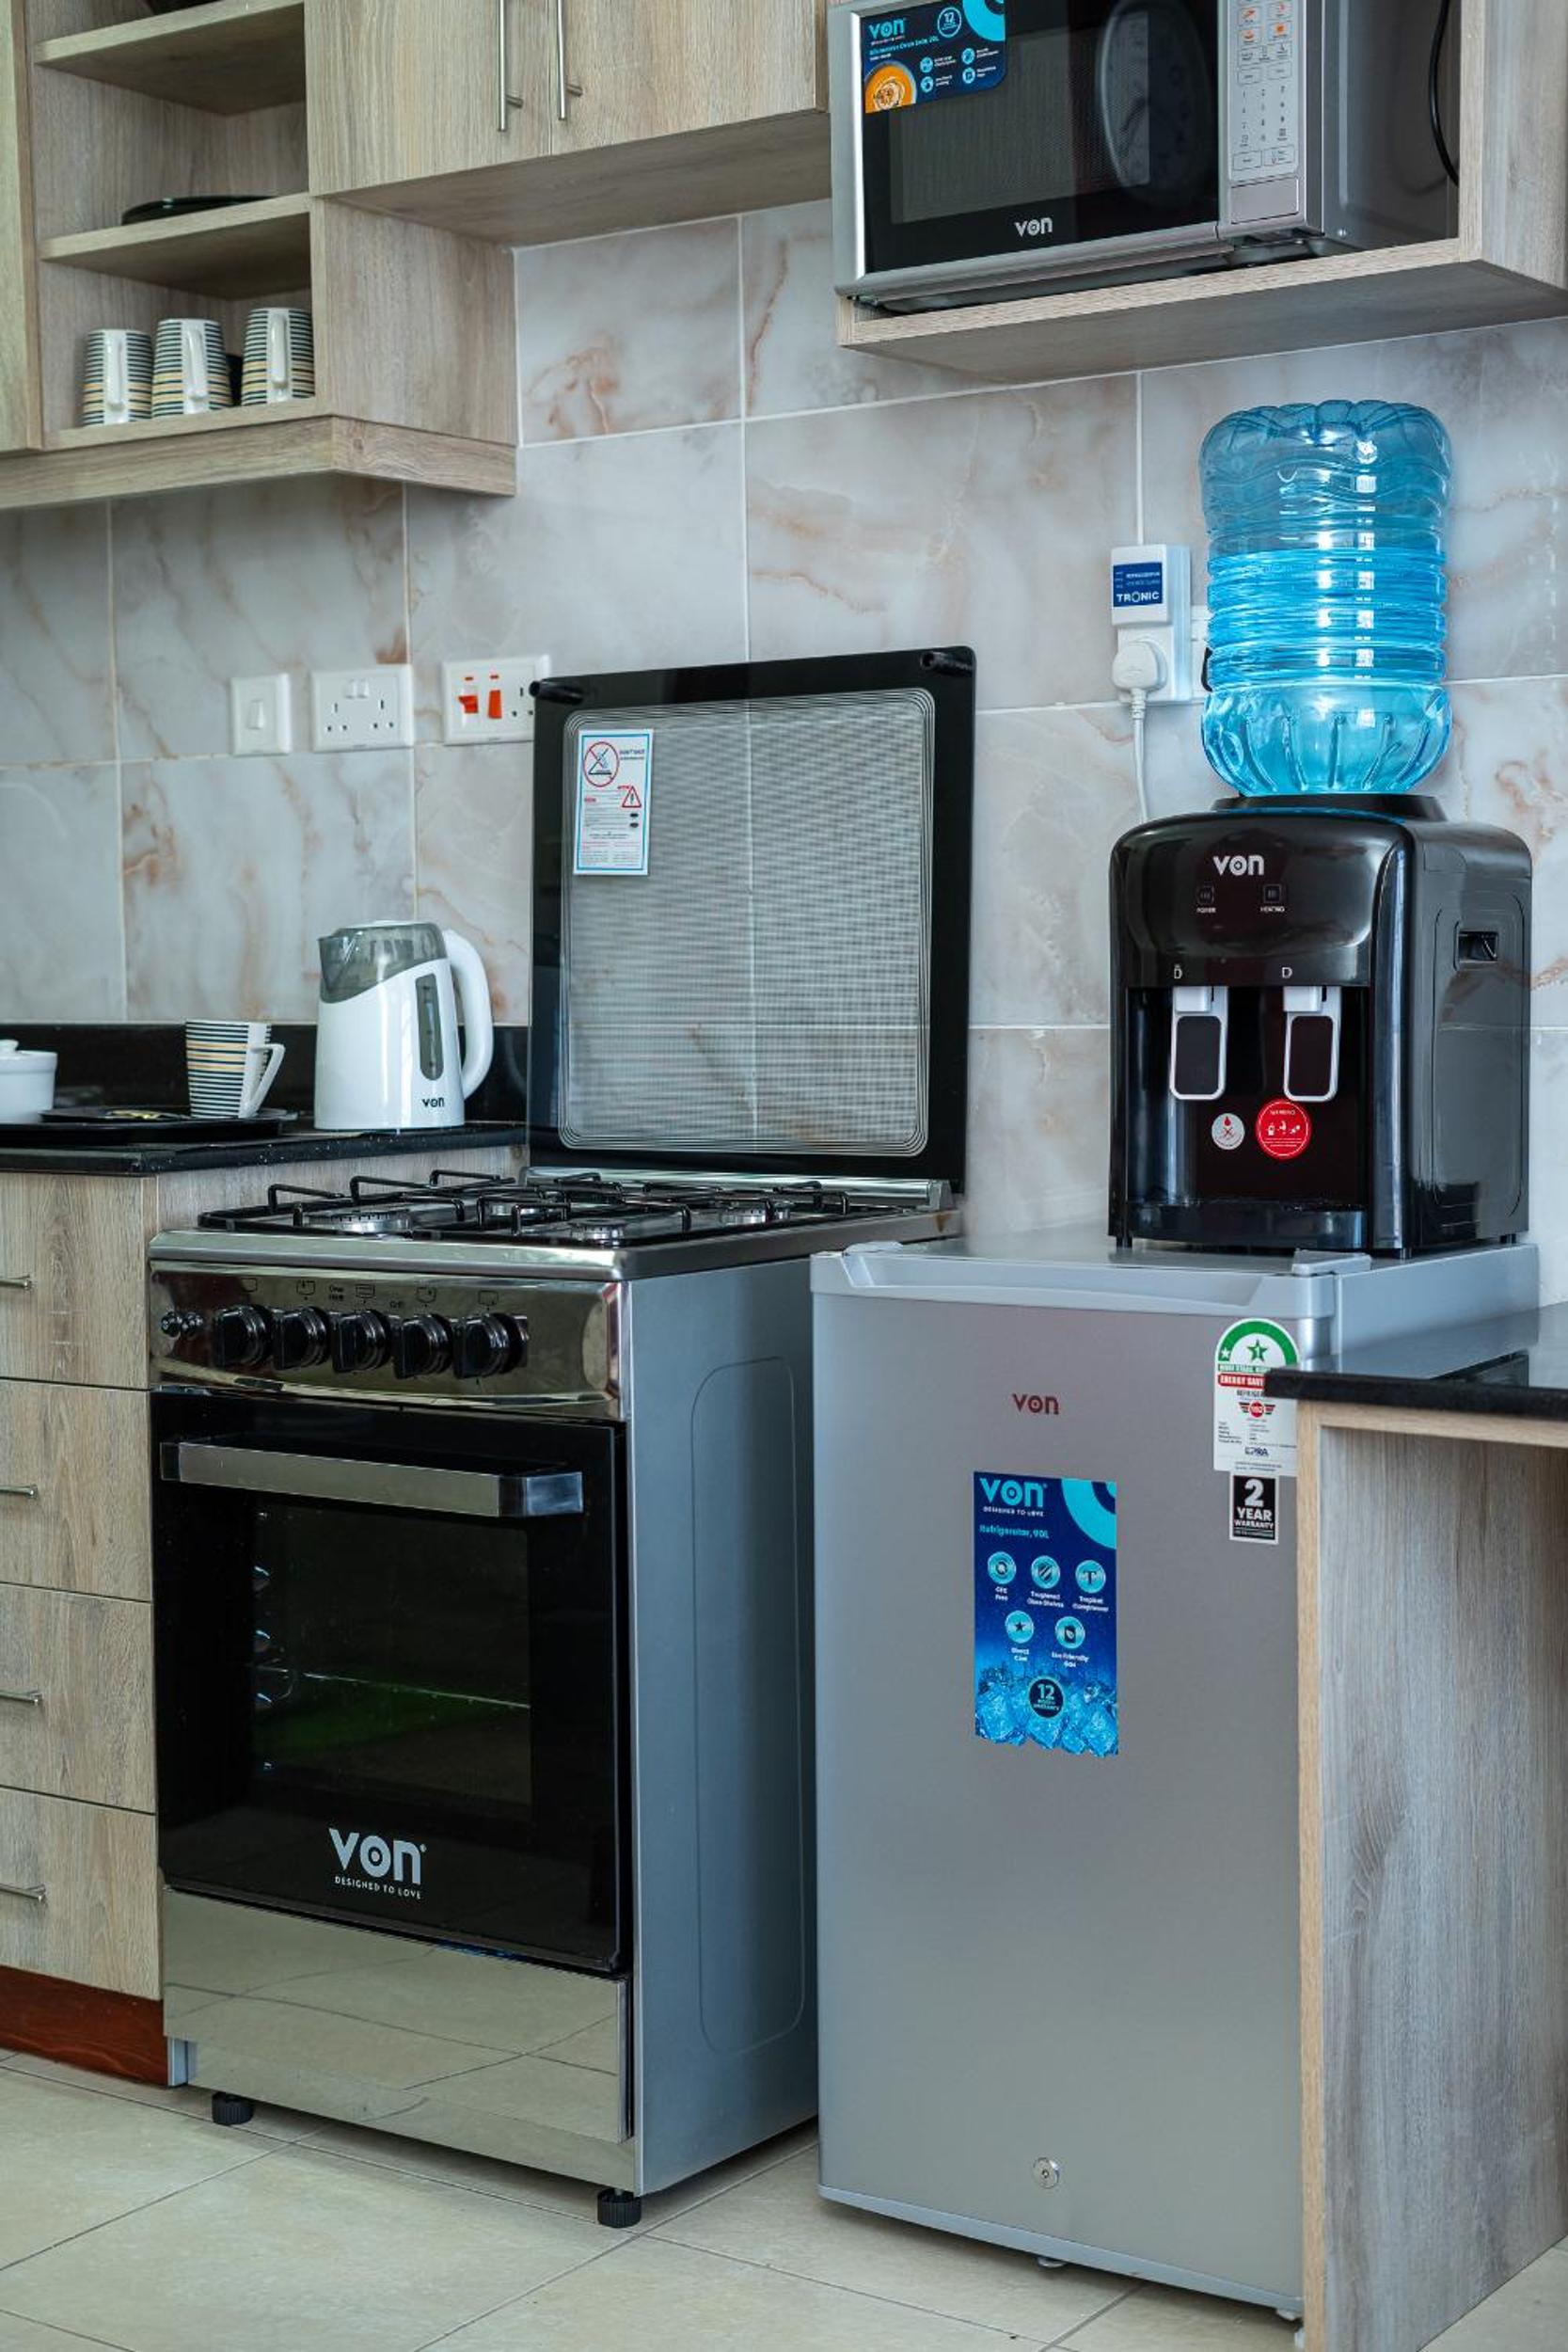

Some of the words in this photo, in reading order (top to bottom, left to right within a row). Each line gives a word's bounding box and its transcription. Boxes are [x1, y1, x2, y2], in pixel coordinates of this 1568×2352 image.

[1117, 591, 1160, 603] TRONIC
[1244, 1478, 1265, 1507] 2
[1236, 1506, 1273, 1522] YEAR
[1234, 1518, 1275, 1530] WARRANTY
[1037, 1683, 1055, 1700] 12
[335, 1876, 380, 1891] DESIGNED
[383, 1884, 395, 1894] TO
[397, 1888, 421, 1900] LOVE
